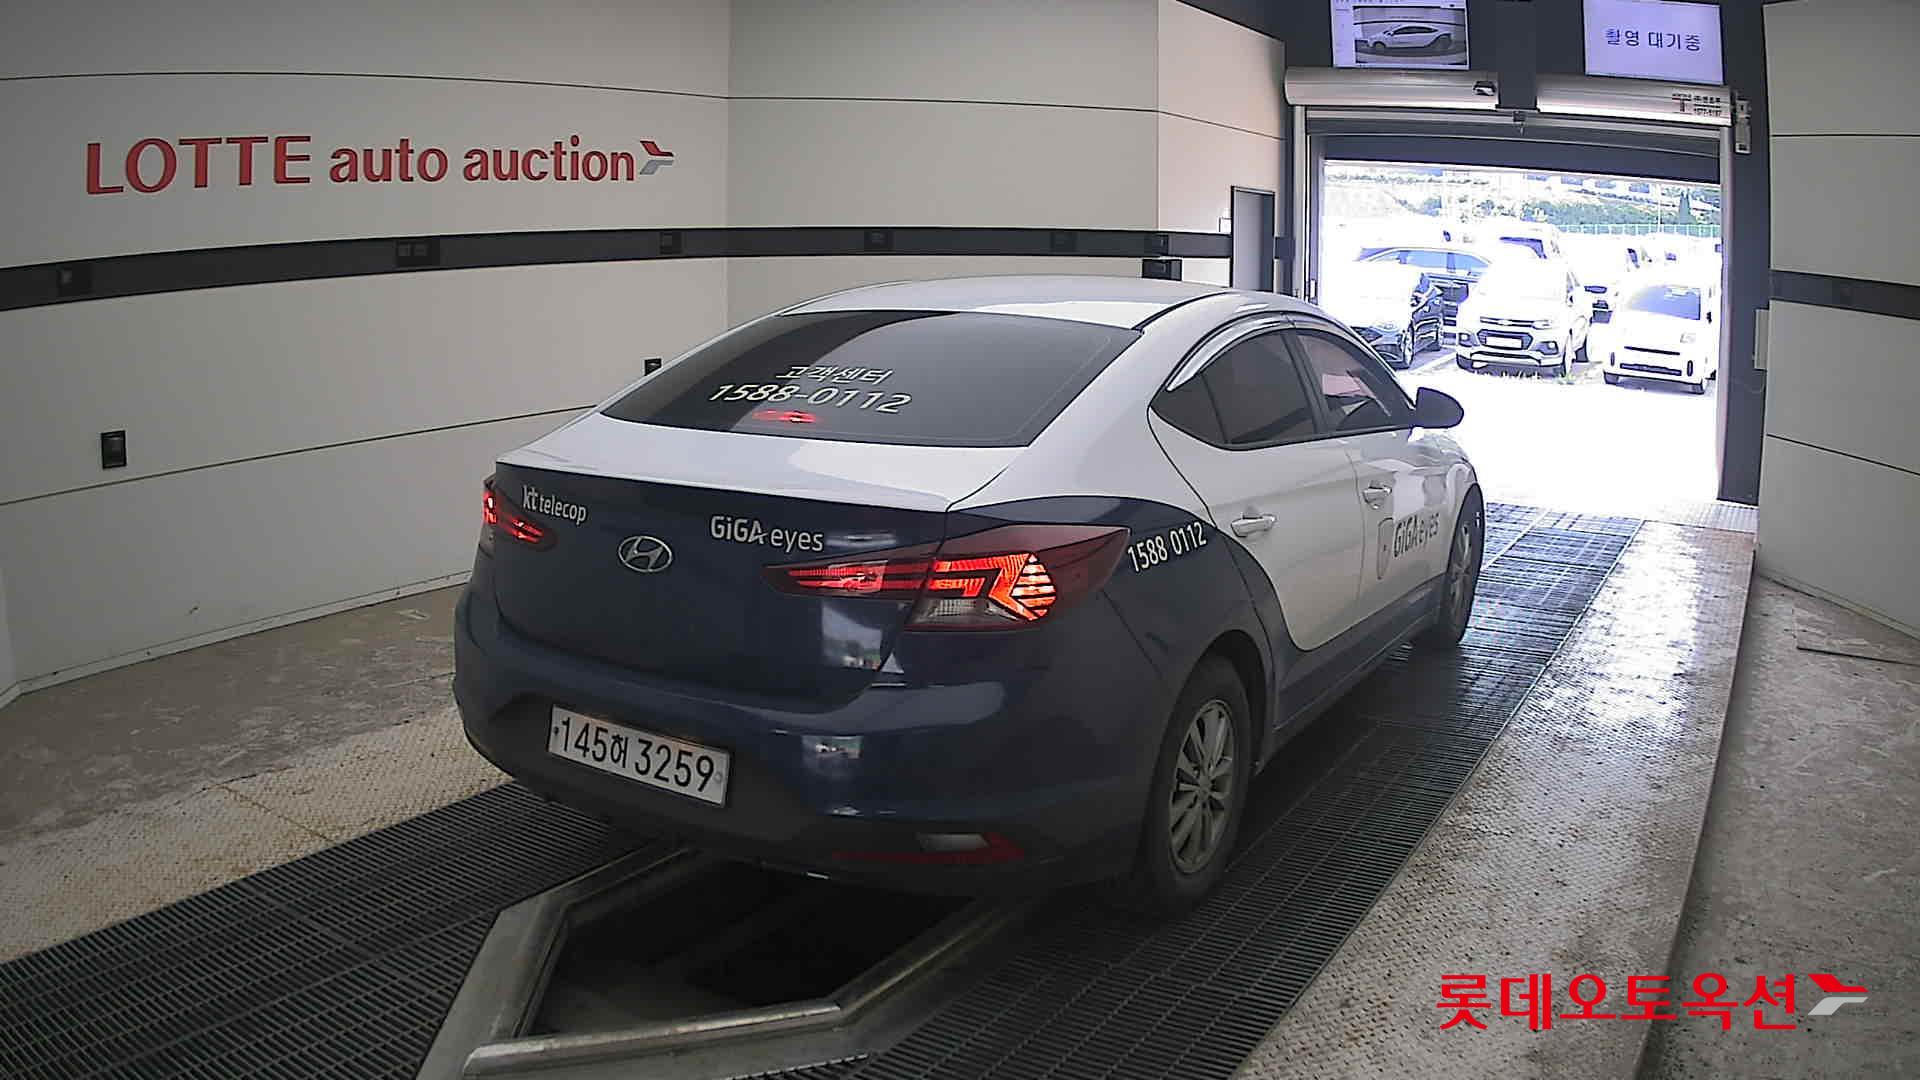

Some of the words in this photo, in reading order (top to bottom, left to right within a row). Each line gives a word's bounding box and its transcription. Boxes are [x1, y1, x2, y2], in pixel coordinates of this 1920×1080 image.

[1648, 32, 1701, 51] 대기중
[86, 135, 312, 194] LOTTE
[329, 138, 449, 182] auto
[463, 135, 635, 182] auction
[775, 365, 894, 385] 고객센터
[709, 384, 912, 413] 1588-0112
[523, 485, 538, 510] kt
[540, 494, 587, 526] telecop
[770, 528, 823, 553] eyes
[1128, 535, 1168, 572] 1588
[1170, 521, 1207, 555] 0112
[562, 717, 629, 769] 145허
[634, 738, 715, 793] 3259
